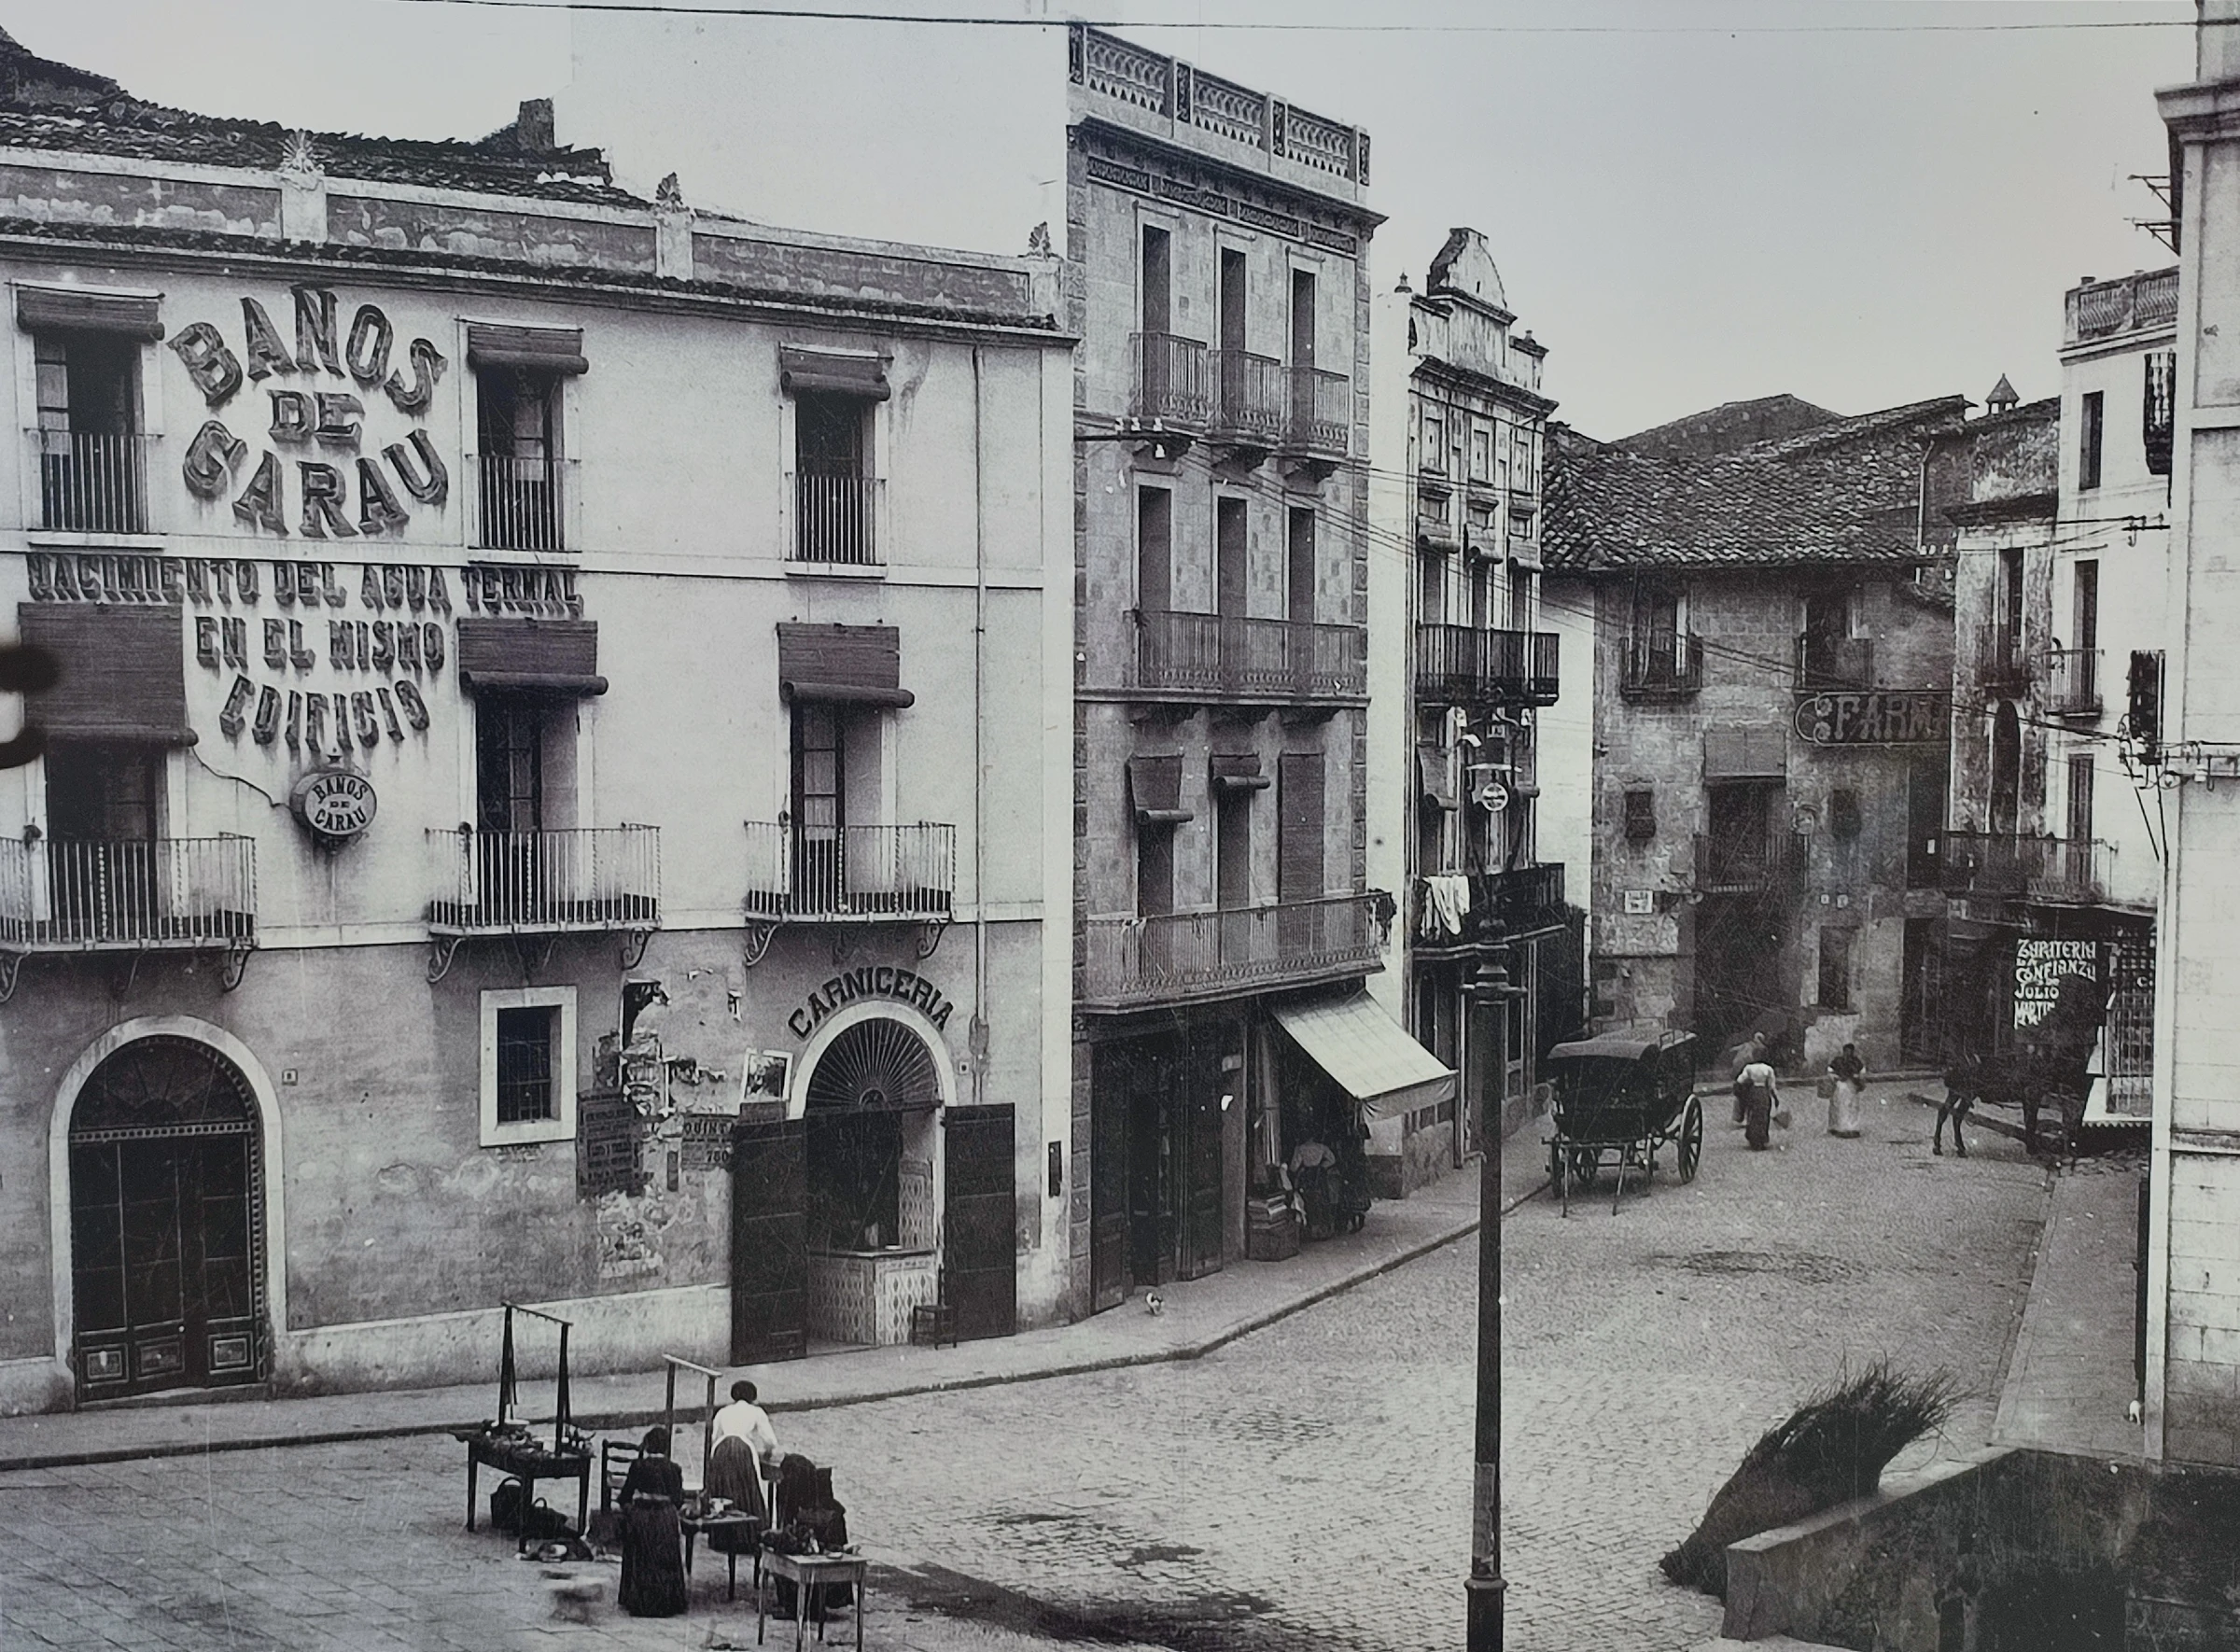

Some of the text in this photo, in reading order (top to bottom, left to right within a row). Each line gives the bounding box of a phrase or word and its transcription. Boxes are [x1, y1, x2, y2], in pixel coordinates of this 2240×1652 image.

[267, 389, 365, 452] DE
[183, 420, 449, 538] GARAU
[26, 553, 584, 617] NACIMIENTO DEL AGUA TERMAL
[195, 616, 445, 673] EN EL MISMO
[219, 674, 430, 752] EDIFICIO
[2017, 938, 2096, 960] ZAPATERIA
[787, 967, 955, 1041] CARNICERIA
